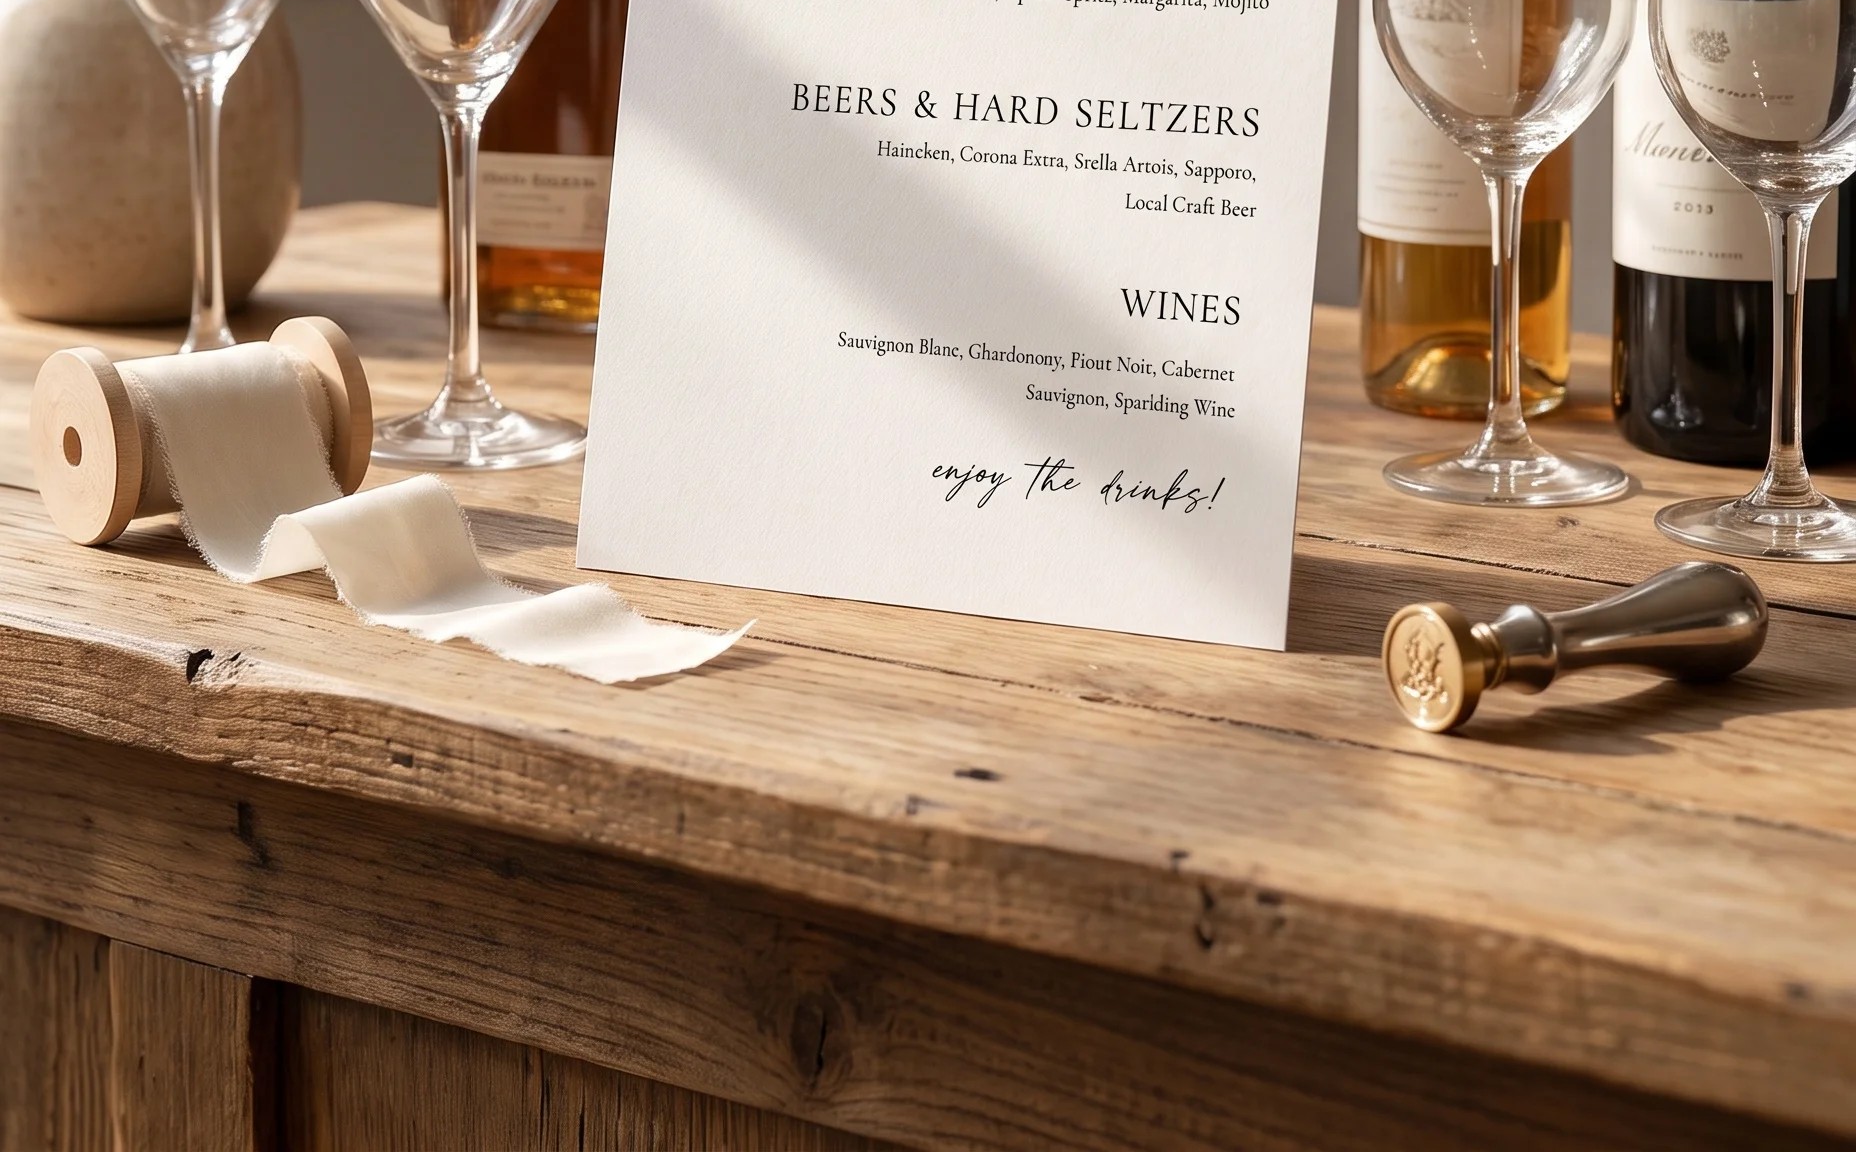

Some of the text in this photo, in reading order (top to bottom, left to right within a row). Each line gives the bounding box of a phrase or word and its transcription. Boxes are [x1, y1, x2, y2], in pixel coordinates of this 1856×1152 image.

[790, 83, 1260, 138] BEERS & HARD SELTZERS
[959, 145, 1018, 165] Corona
[1022, 149, 1069, 172] Extra,
[1122, 156, 1178, 179] Artois,
[1183, 159, 1256, 185] Sapporo,
[1125, 192, 1258, 218] Local Craft Beer
[1120, 287, 1240, 326] WINES
[837, 331, 914, 357] Sauvignon
[918, 337, 964, 362] Blanc,
[968, 342, 1065, 373] Ghardonony,
[1070, 351, 1113, 372] Piout
[1161, 359, 1236, 382] Cabernet
[1025, 383, 1109, 410] Sauvignon,
[931, 456, 1226, 514] enjoy the drinks!
